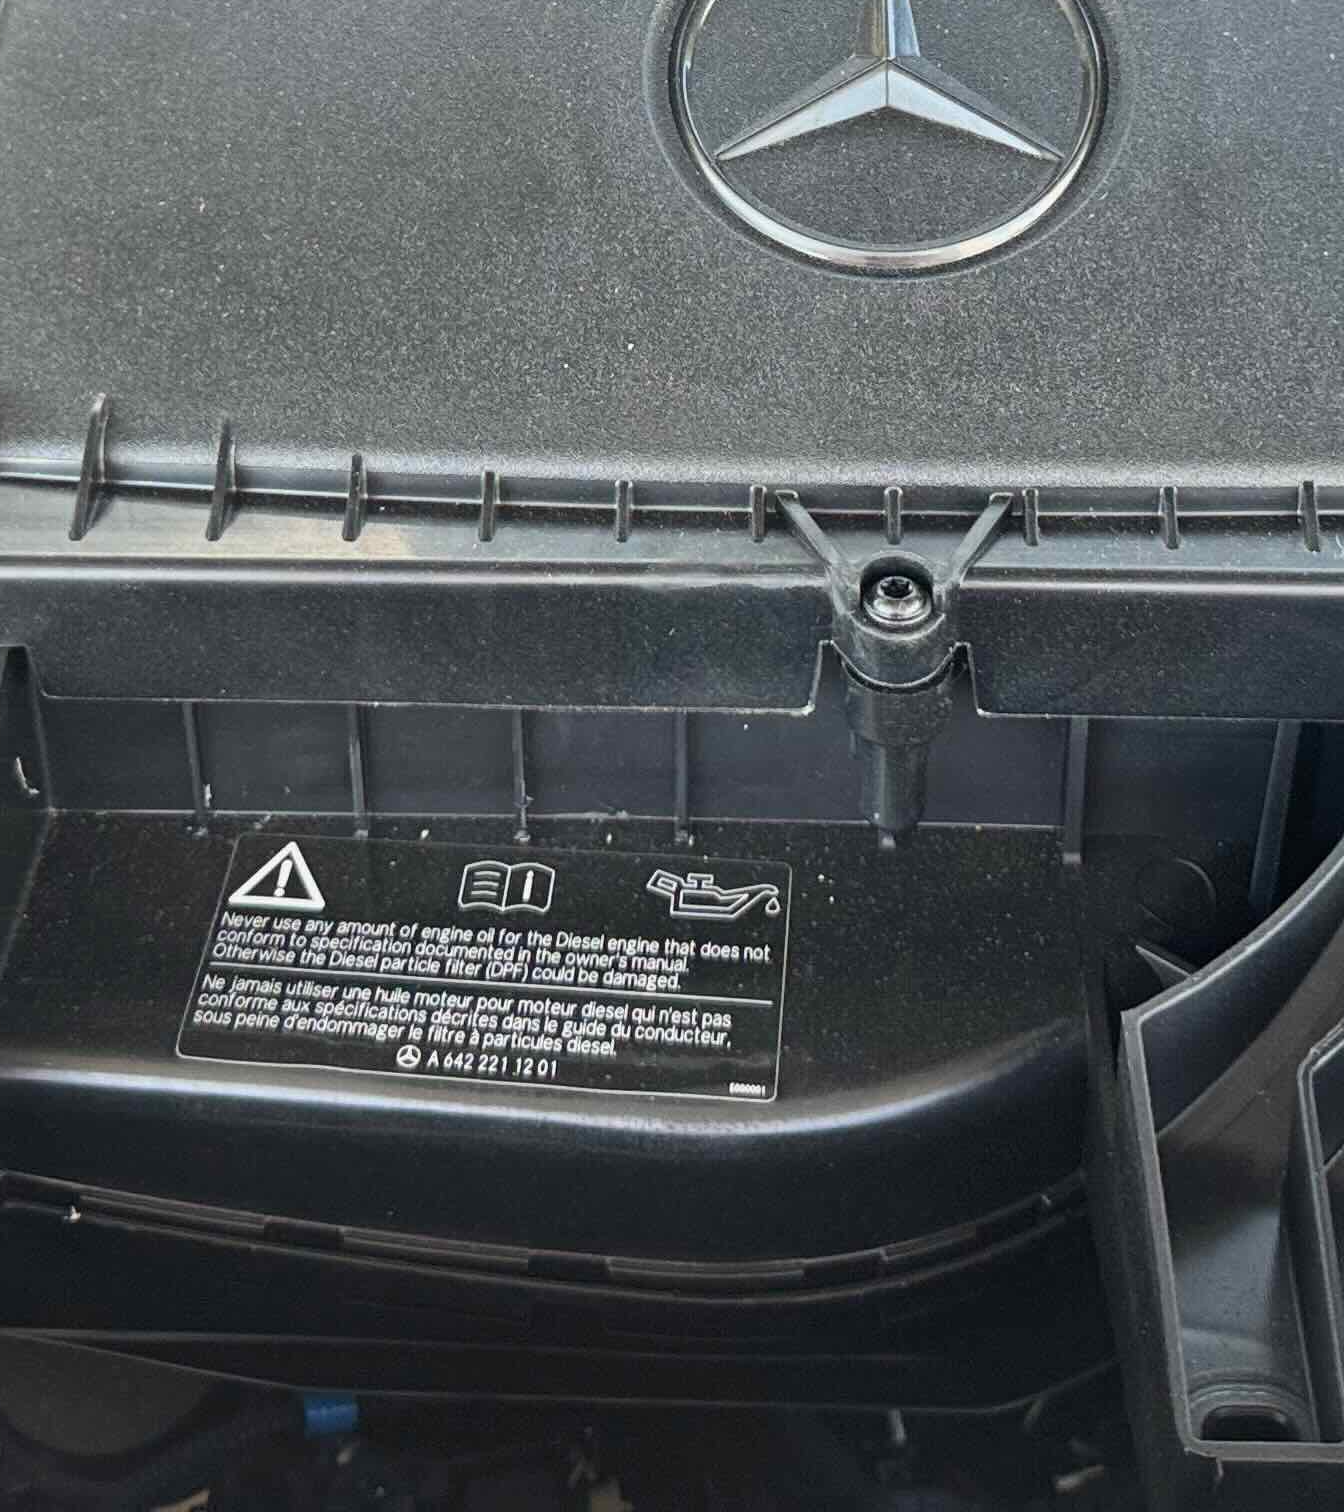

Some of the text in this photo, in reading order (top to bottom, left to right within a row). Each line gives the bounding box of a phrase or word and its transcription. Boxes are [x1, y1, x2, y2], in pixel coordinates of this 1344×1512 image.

[217, 928, 689, 973] conform to specification documented in the owner's manual.
[221, 911, 770, 962] Never use any amount of engine oil for the Diesel engine that does not
[212, 943, 681, 990] Otherwise the Diesel particle filter (DPF) could be damaged.
[197, 992, 732, 1048] conforme aux spécifications décrites dans le guide du conducteur,
[202, 973, 732, 1029] Ne jamais utiliser une huile moteur pour moteur diesel qui n'est pas
[193, 1008, 617, 1057] sous peine d'endommager le filtre à particules diesel.
[426, 1050, 557, 1078] A 642 221 12 01
